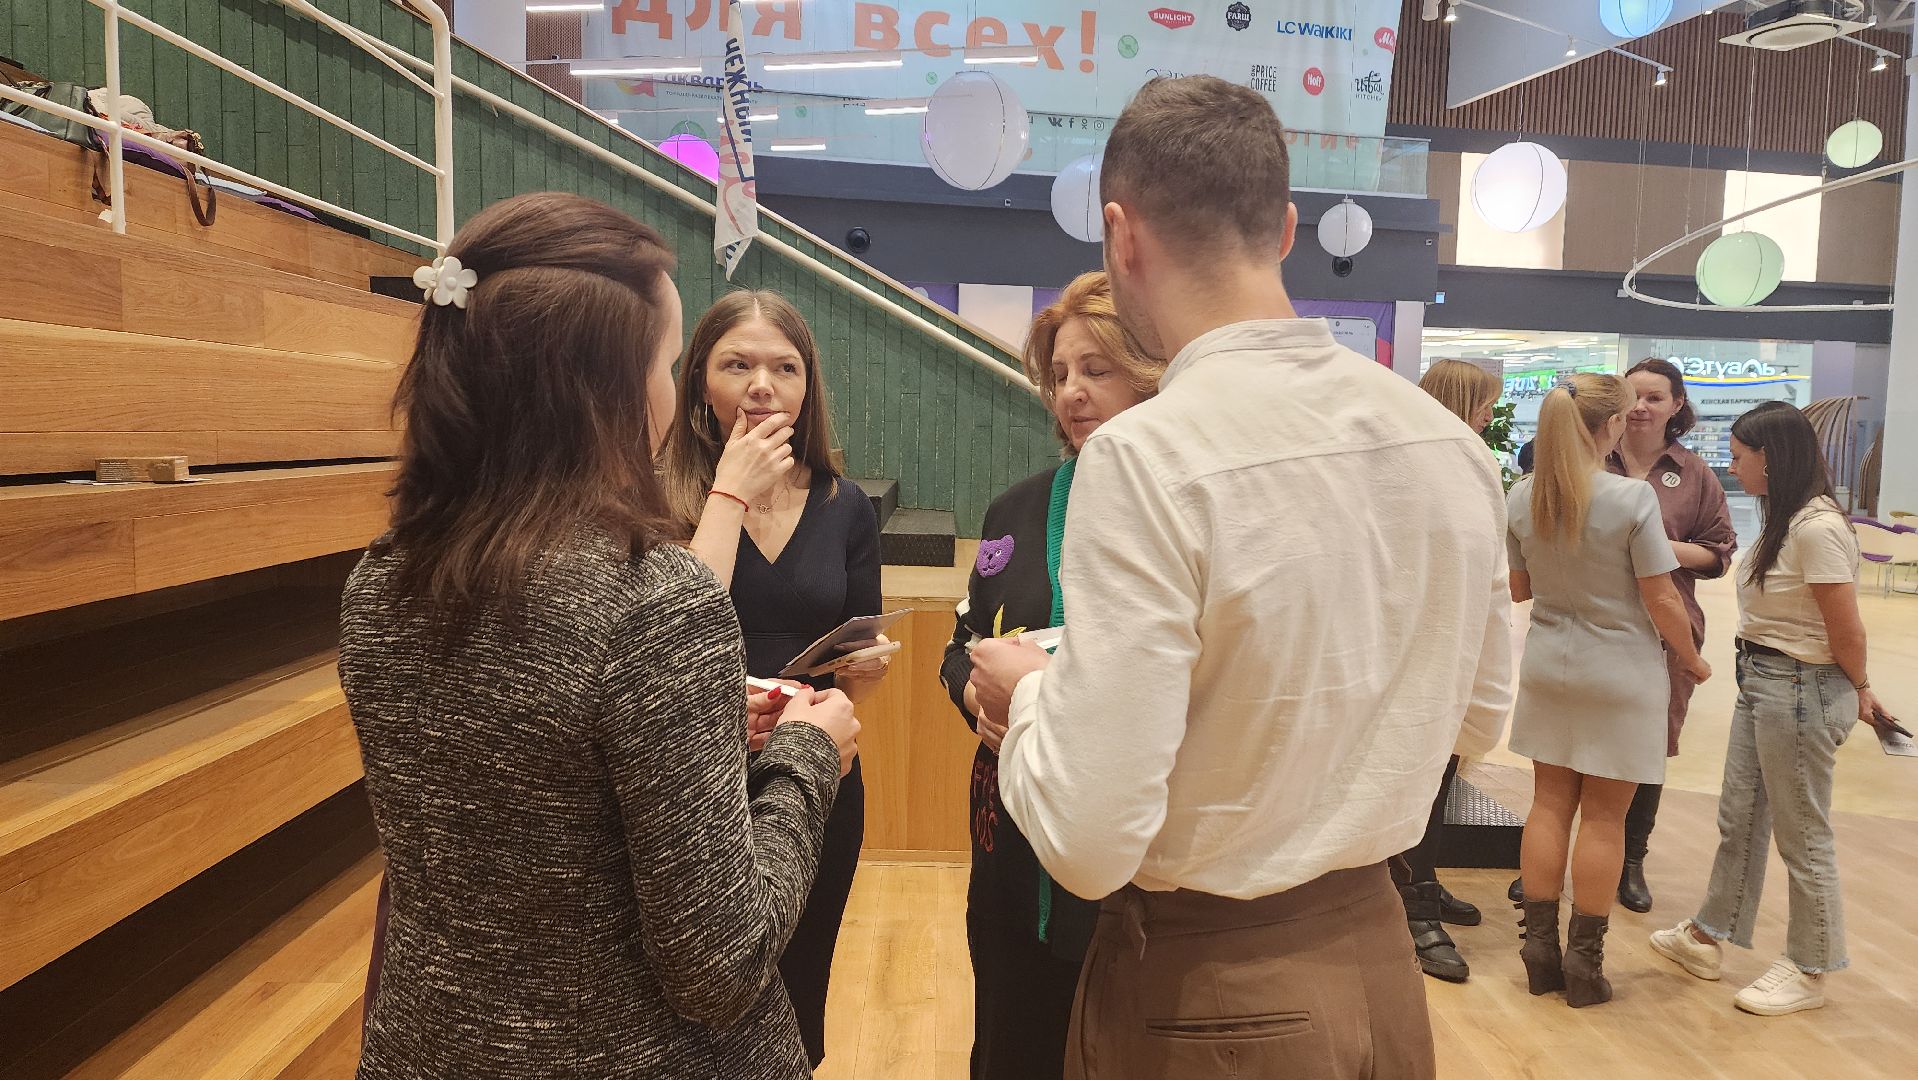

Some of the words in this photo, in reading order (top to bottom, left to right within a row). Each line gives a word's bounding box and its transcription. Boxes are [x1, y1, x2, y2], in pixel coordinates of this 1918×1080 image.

[1153, 12, 1192, 22] SUNLIGHT
[1277, 20, 1296, 34] LC
[854, 2, 1097, 74] всех!
[1256, 64, 1277, 79] PRICE
[1250, 77, 1277, 92] COFFEE
[1307, 73, 1322, 87] Hoff
